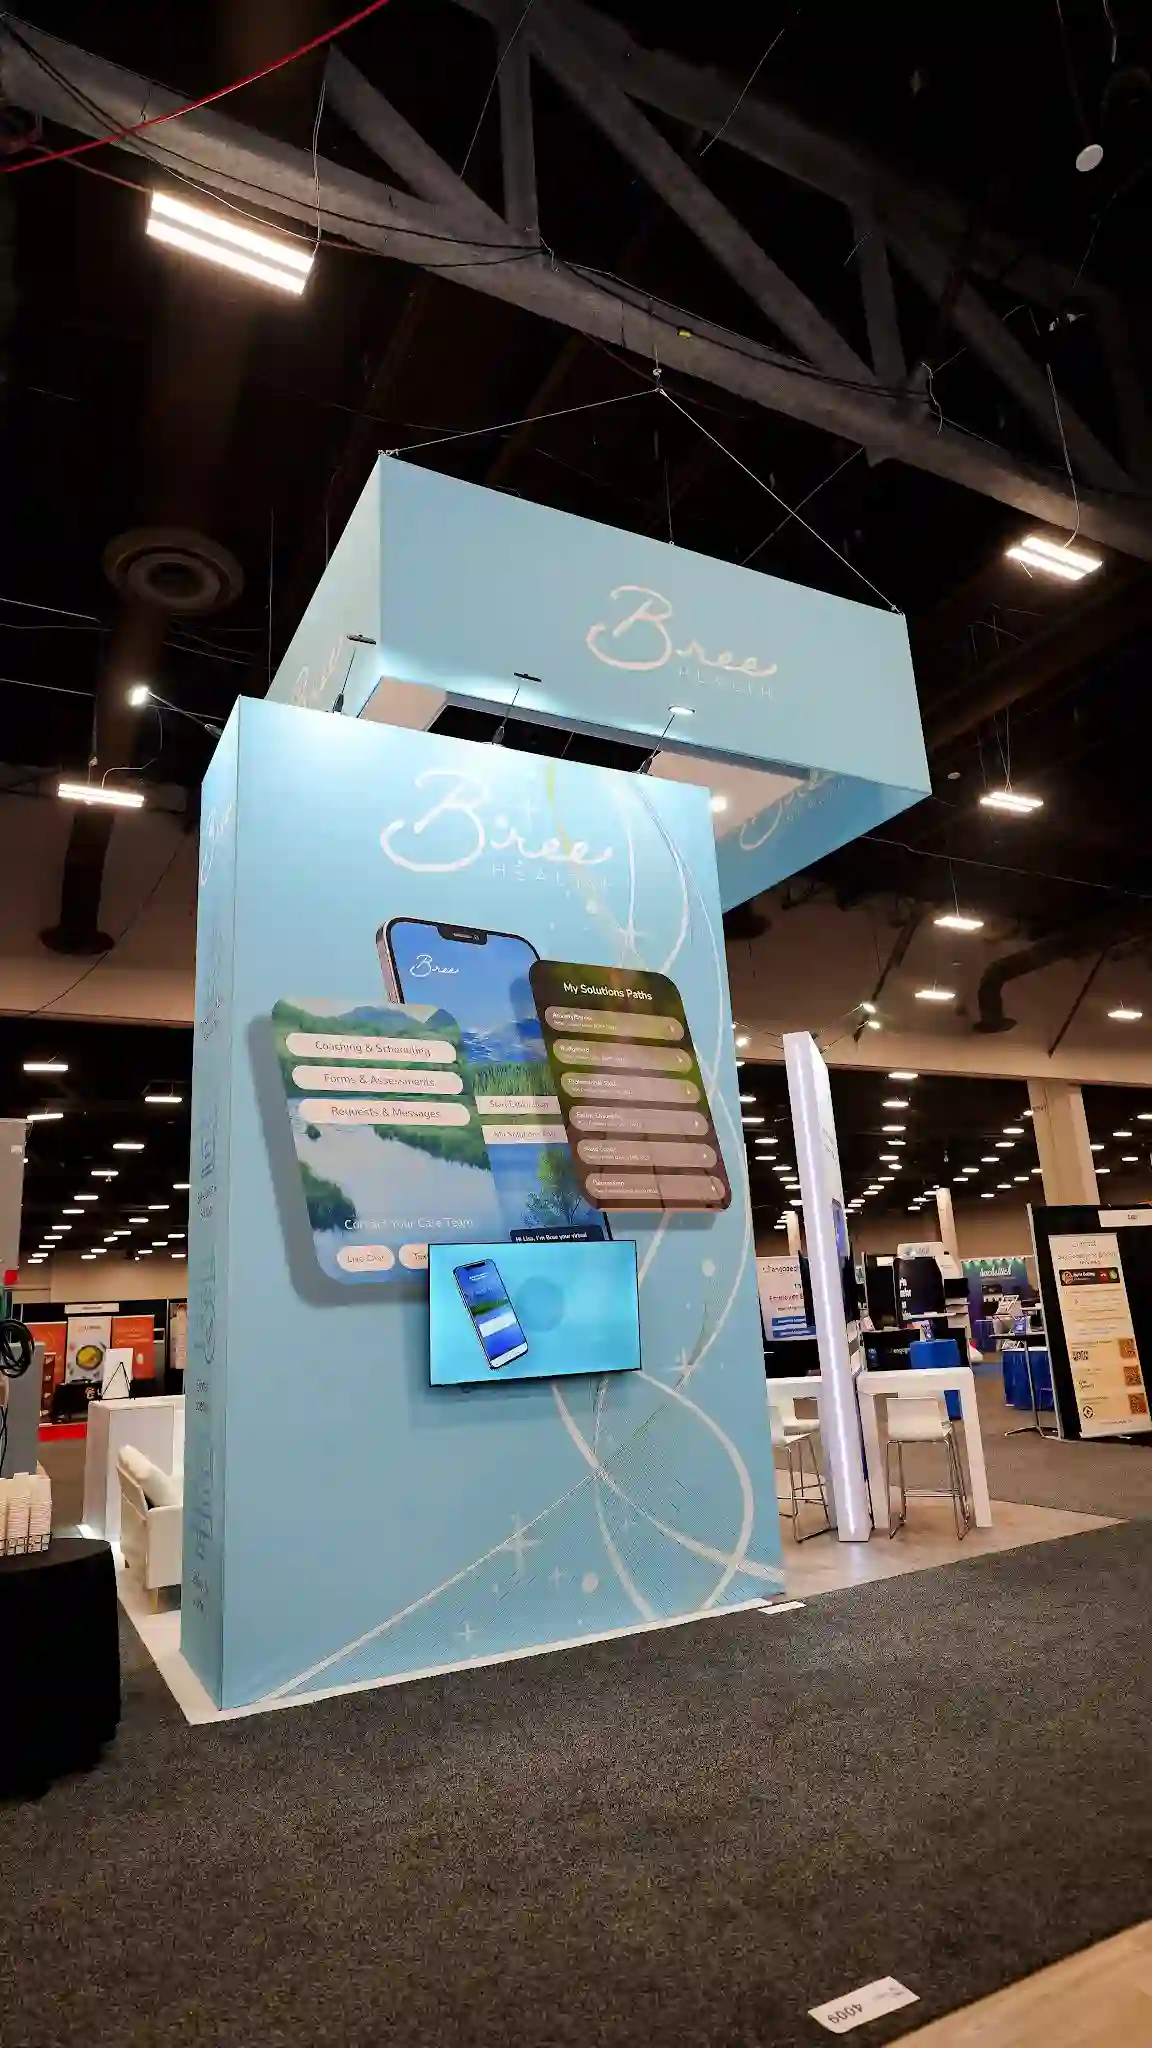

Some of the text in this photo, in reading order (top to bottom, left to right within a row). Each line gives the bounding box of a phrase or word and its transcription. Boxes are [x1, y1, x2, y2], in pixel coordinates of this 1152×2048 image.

[586, 584, 777, 676] Bree
[379, 769, 614, 873] Bree
[409, 954, 460, 978] Bree
[563, 981, 653, 1001] My Solutions Paths
[315, 1040, 432, 1058] Coaching & Scheduling
[323, 1072, 436, 1088] Forms & Assessments
[331, 1106, 441, 1121] Requests & Messages
[417, 1217, 442, 1229] Care
[443, 1217, 473, 1229] Team
[827, 2003, 862, 2024] 4009
